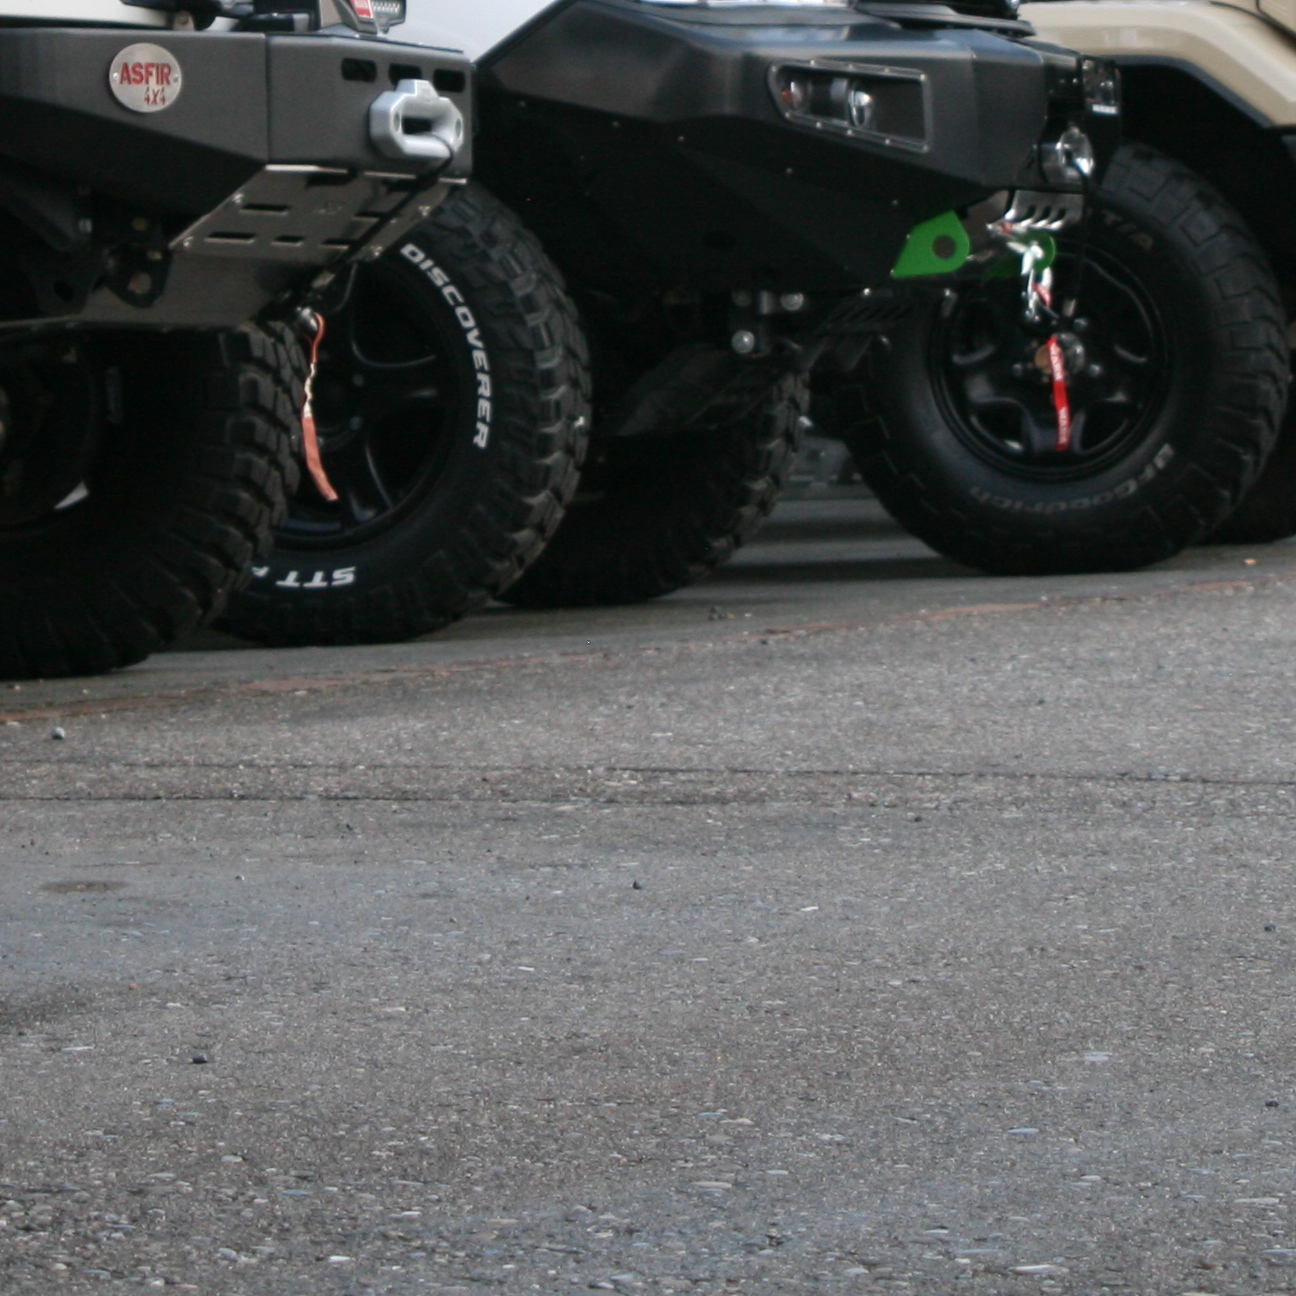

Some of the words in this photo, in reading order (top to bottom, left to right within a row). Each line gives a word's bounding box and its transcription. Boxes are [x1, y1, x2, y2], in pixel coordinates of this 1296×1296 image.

[119, 62, 171, 85] ASFIR
[400, 243, 493, 450] DISCOVERER
[275, 566, 356, 588] STT
